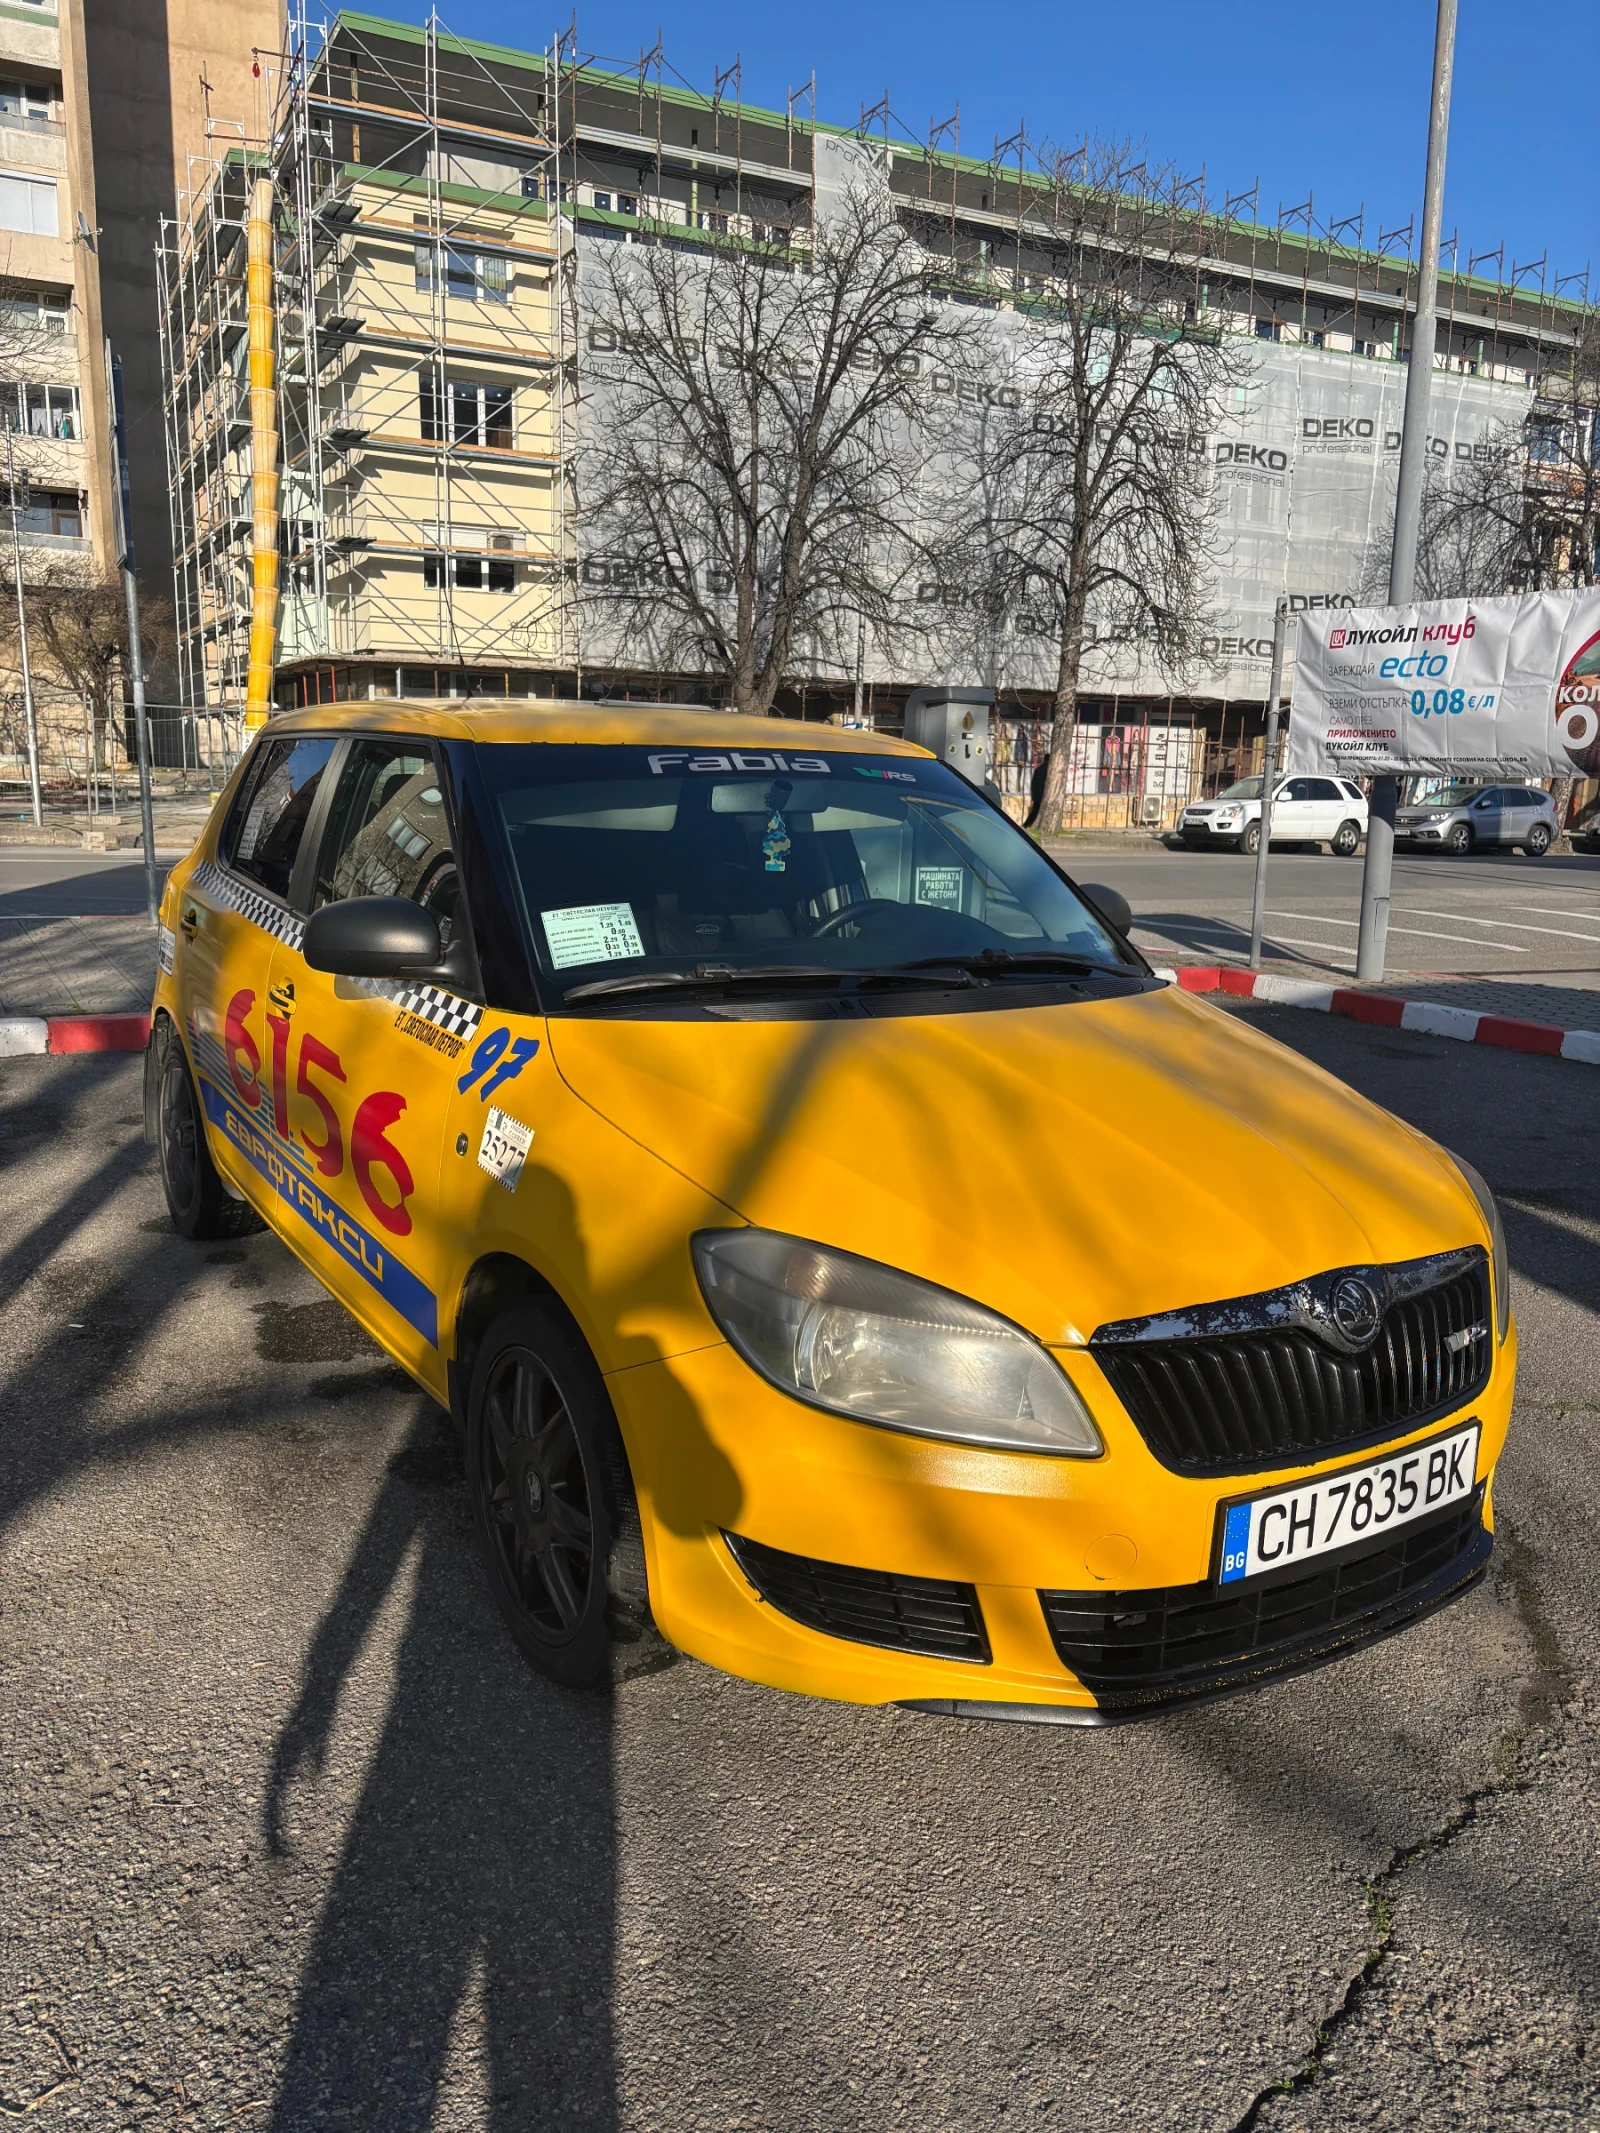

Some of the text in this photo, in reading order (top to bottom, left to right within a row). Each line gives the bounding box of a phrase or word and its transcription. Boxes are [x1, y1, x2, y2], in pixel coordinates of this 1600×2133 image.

[931, 372, 1022, 409] DEKO
[1303, 418, 1374, 438] DEKO
[1215, 443, 1287, 471] DEKO
[1302, 444, 1372, 454] professional
[1455, 442, 1522, 464] DEK
[1346, 625, 1418, 645] ЛУКОЙЛ
[1422, 616, 1476, 645] клуб
[1201, 637, 1275, 657] DEKO
[1328, 650, 1448, 678] ЗАРЕЖДАЙ ecto
[1329, 698, 1357, 709] ВЗЕМИ
[1359, 697, 1408, 709] ОТСТЪПКА
[1410, 689, 1465, 719] 0,08
[1329, 716, 1373, 725] САМО ПРЕЗ
[1327, 730, 1397, 739] ПРИЛОЖЕНИЕТО
[1365, 742, 1389, 751] КЛУБ
[647, 753, 831, 774] Fabia
[920, 872, 960, 881] МАШИНАТА
[925, 881, 954, 890] РАБОТИ
[928, 890, 958, 899] ЖЕТОНИ
[394, 1011, 406, 1028] ЕТ
[457, 1027, 540, 1102] 97
[225, 988, 415, 1236] 6156
[481, 1129, 526, 1178] 25277
[225, 1110, 383, 1283] ЕВРОТАКСИ
[1225, 1552, 1245, 1572] BG
